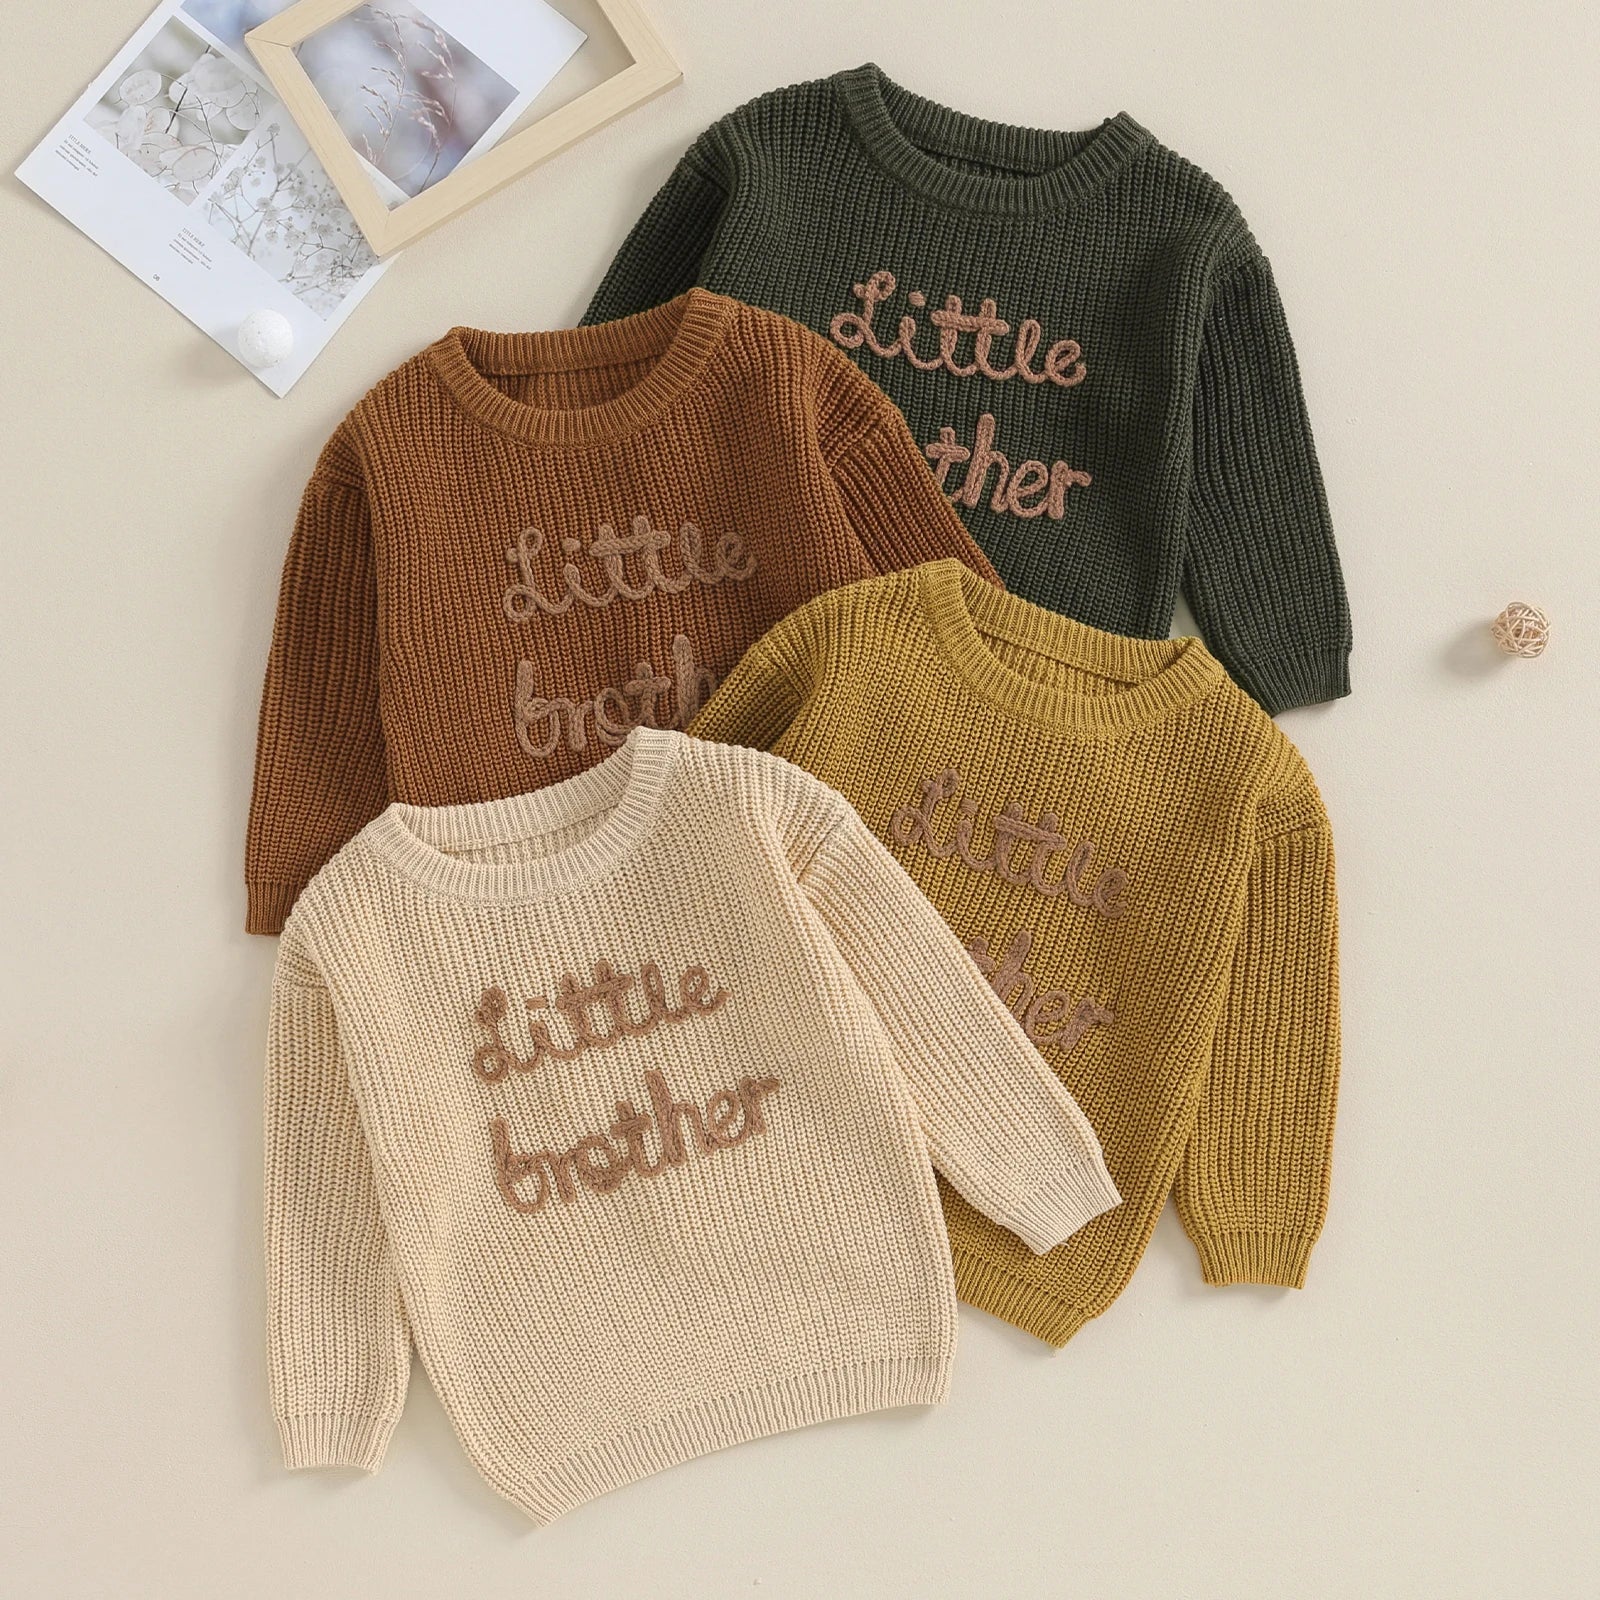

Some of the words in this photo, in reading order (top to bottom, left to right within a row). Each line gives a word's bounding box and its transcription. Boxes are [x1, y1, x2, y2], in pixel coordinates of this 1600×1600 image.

[829, 270, 1087, 387] Little
[503, 515, 758, 622] Little
[892, 768, 1128, 918] Little
[472, 958, 733, 1085] Little
[491, 1070, 780, 1214] brother
